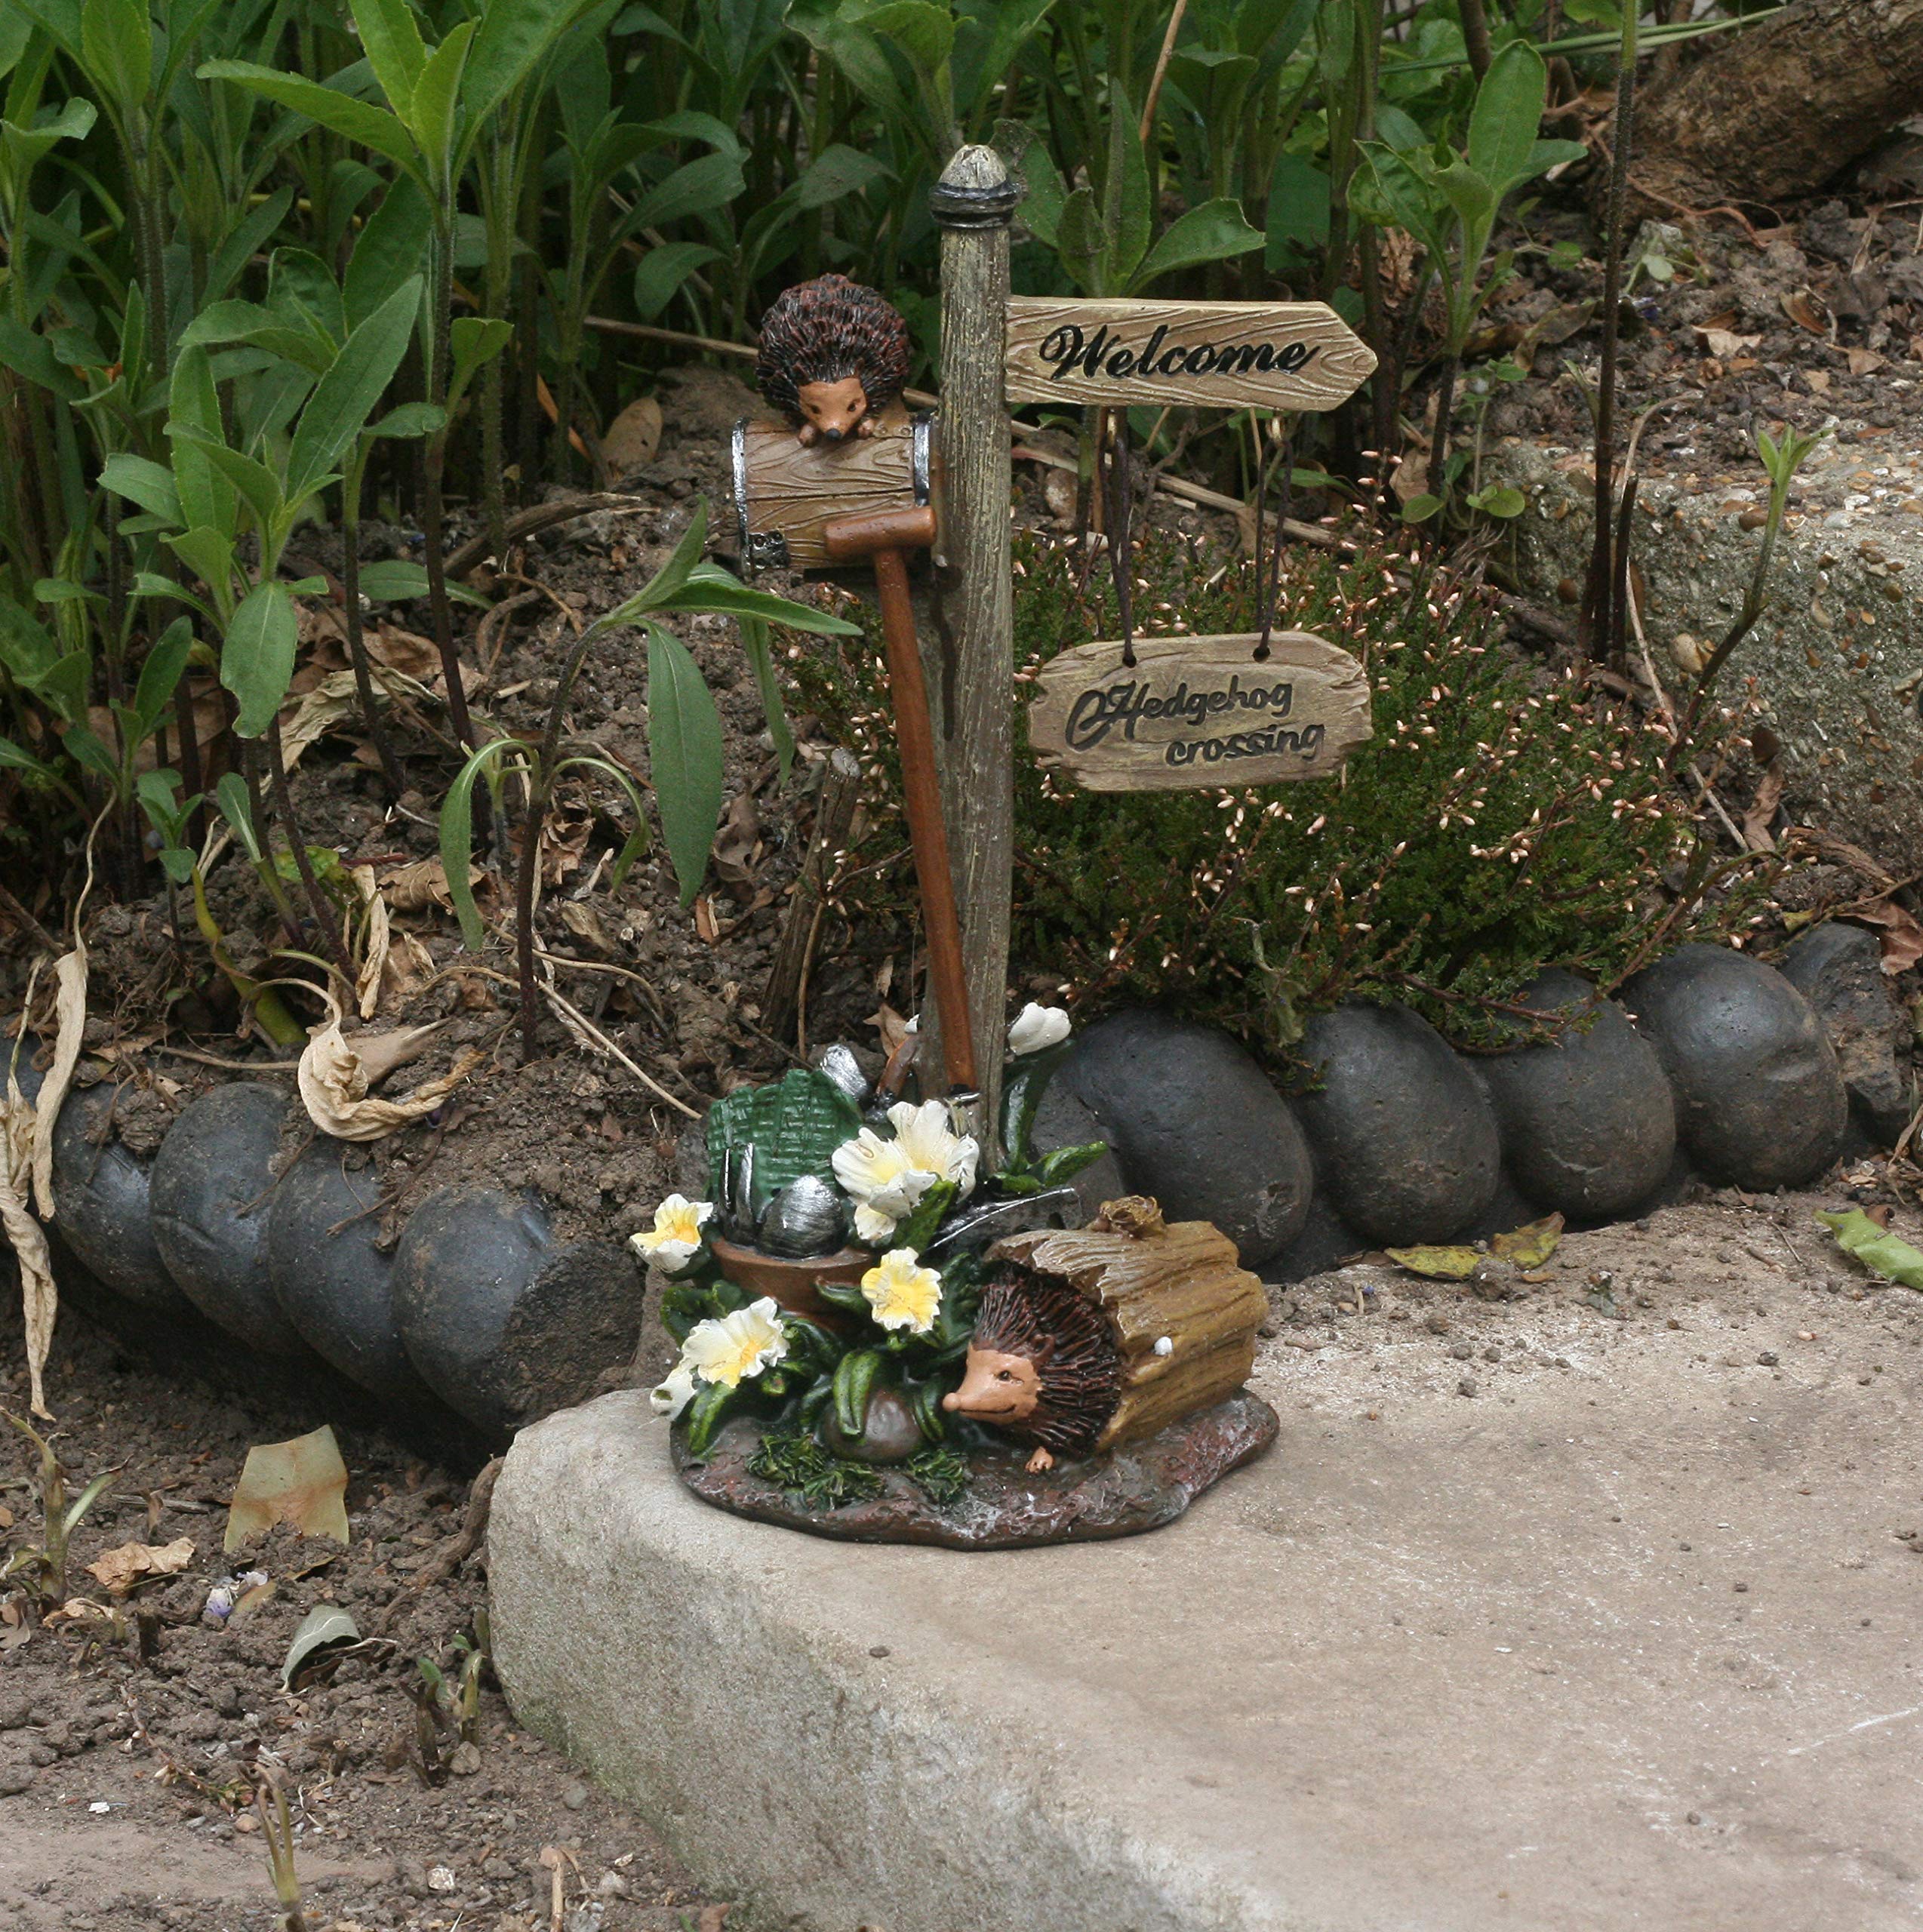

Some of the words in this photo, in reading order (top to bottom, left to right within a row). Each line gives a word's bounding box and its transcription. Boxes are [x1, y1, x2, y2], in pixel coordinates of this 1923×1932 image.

[1038, 324, 1321, 379] Welcome
[1065, 675, 1293, 752] Hedgehog
[1165, 724, 1325, 766] crossing
